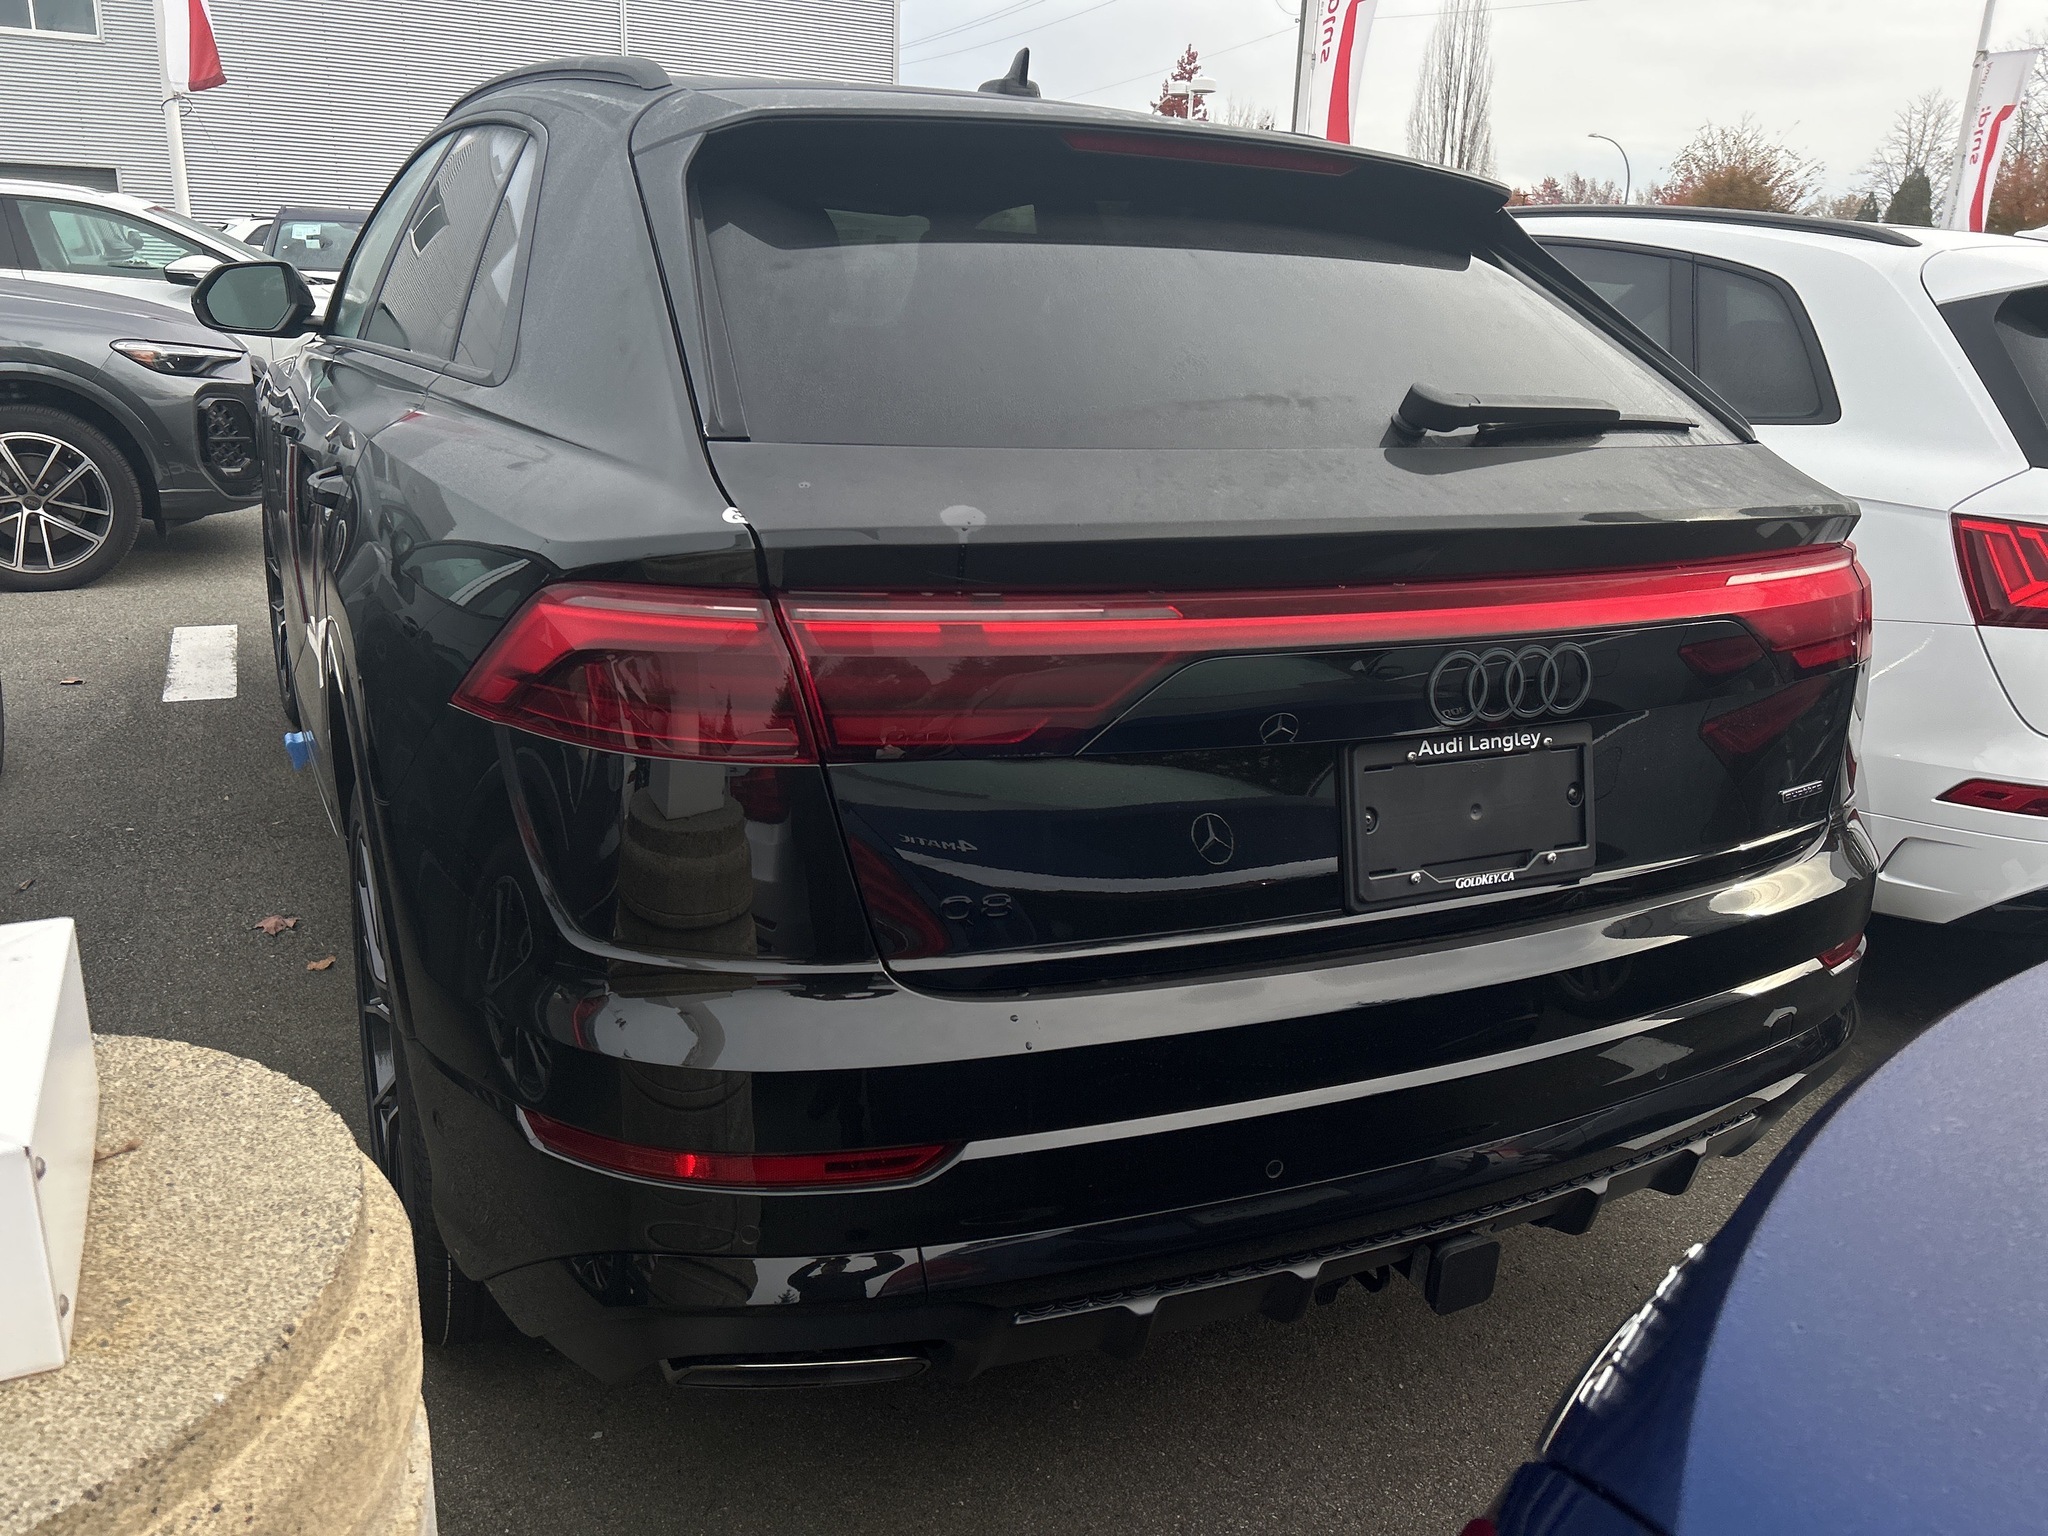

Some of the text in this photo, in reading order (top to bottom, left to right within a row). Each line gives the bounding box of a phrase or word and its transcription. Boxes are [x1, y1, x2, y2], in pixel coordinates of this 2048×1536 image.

[1418, 732, 1542, 757] Audi Langley
[940, 893, 1013, 925] Q8
